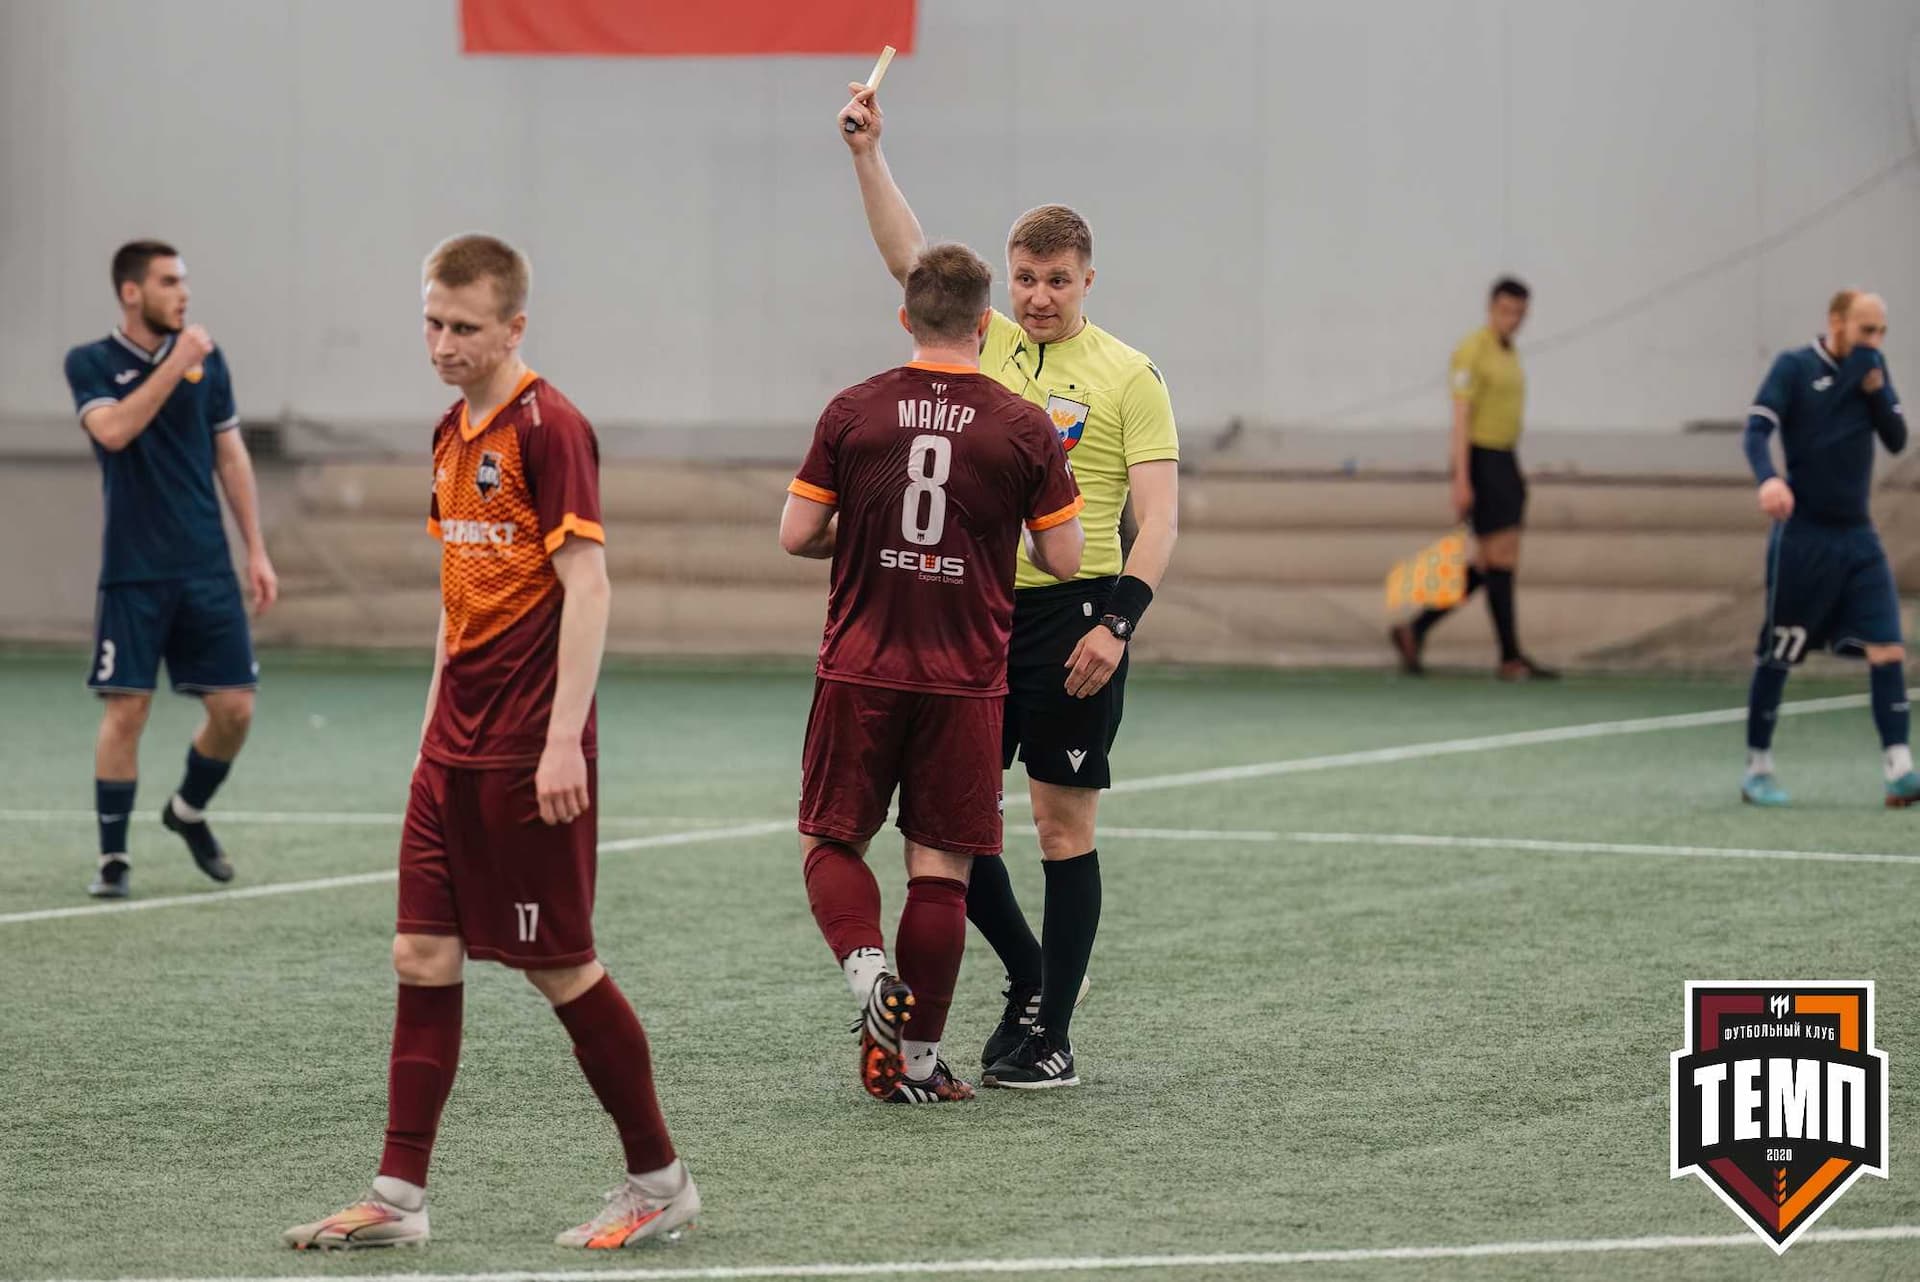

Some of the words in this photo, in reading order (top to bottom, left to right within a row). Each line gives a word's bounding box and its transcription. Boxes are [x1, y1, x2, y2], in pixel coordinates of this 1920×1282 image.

[897, 399, 977, 433] МАЙЕР
[901, 434, 953, 546] 8
[879, 548, 966, 577] SEUS
[918, 572, 942, 583] Export
[942, 575, 965, 585] Union
[97, 639, 116, 681] 3
[1772, 625, 1808, 662] 77
[514, 902, 540, 943] 17
